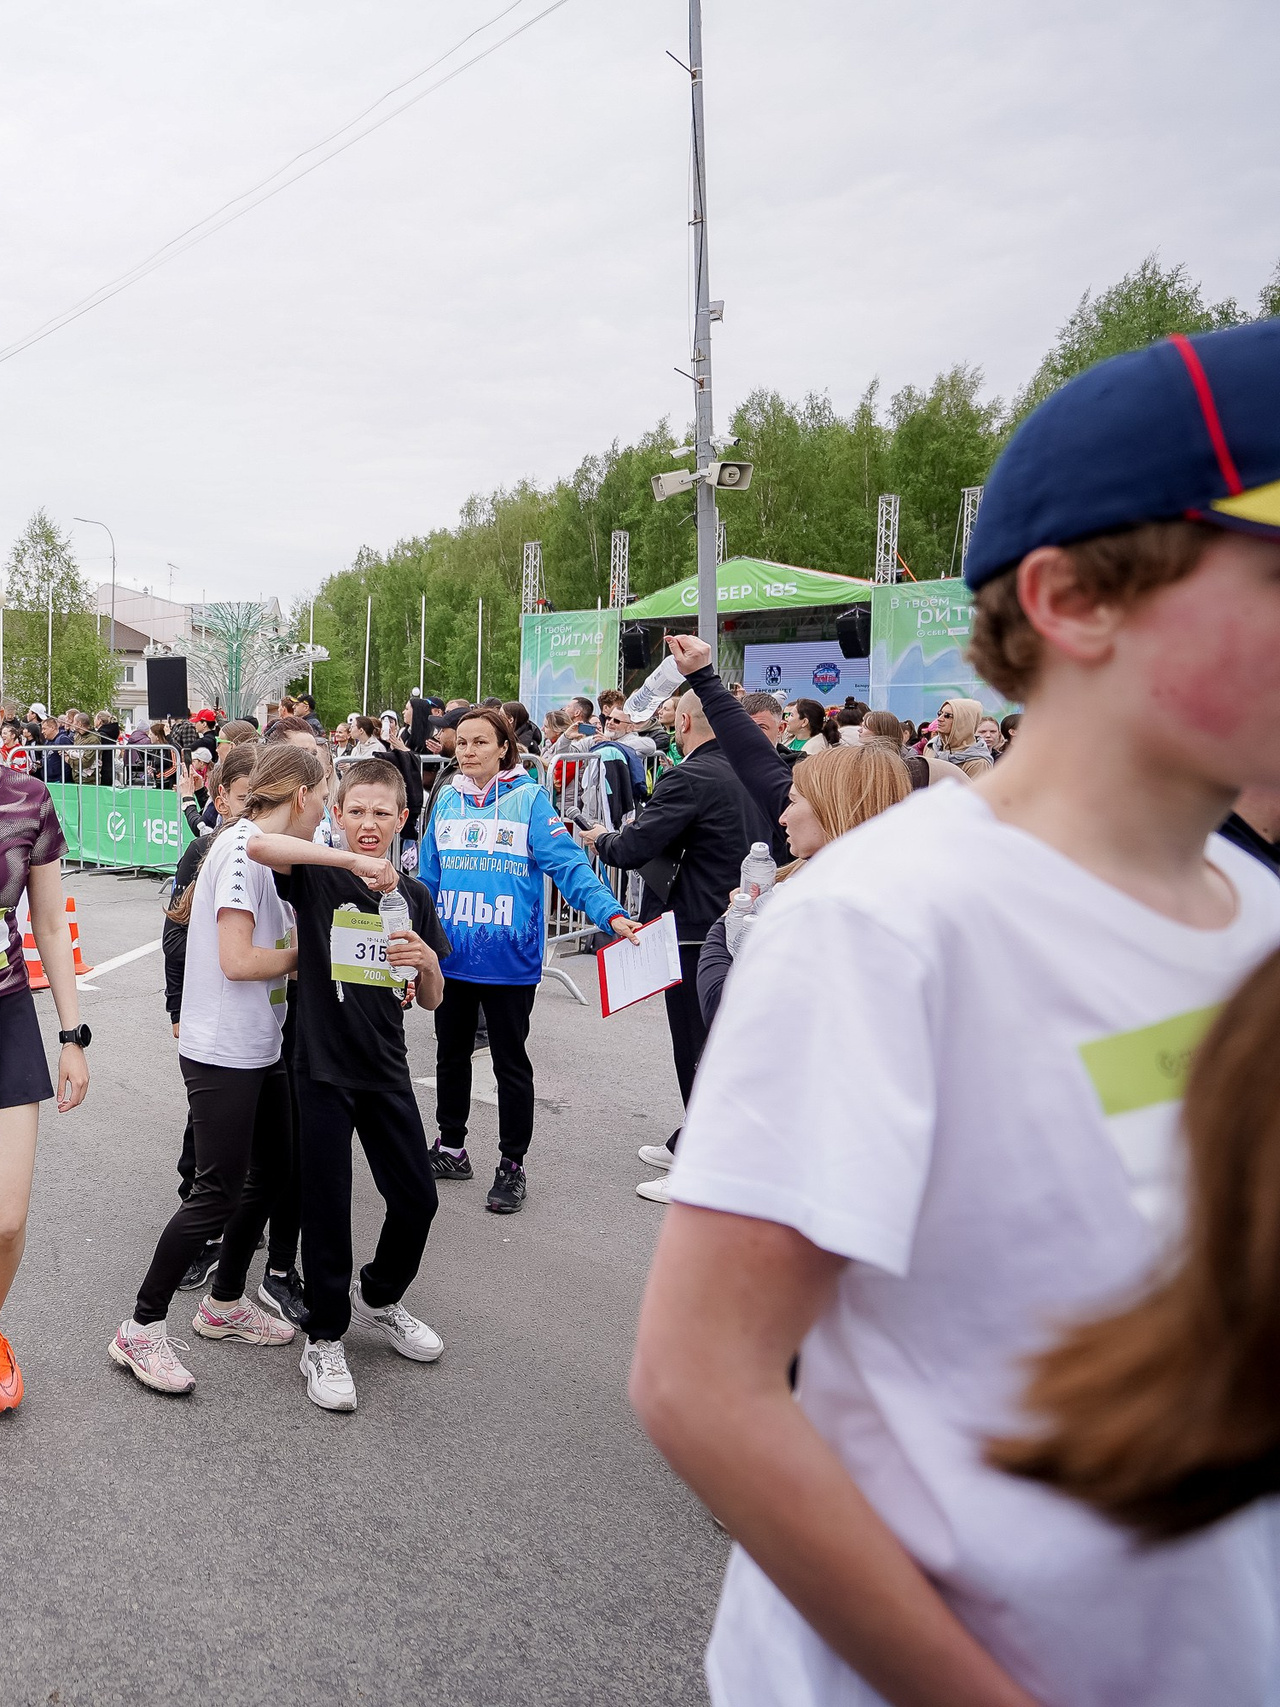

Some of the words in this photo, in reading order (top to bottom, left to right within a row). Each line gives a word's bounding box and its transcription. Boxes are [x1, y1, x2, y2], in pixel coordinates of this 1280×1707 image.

[717, 585, 753, 601] БЕР
[763, 582, 798, 597] 185
[891, 597, 900, 609] В
[905, 595, 950, 609] твоём
[917, 605, 979, 629] ритм
[544, 624, 572, 634] твоём
[551, 632, 604, 650] ритме
[143, 818, 184, 847] 185
[479, 856, 502, 873] ЮГРА
[503, 859, 530, 878] РОССИ
[355, 943, 388, 962] 315
[363, 969, 386, 981] 700м
